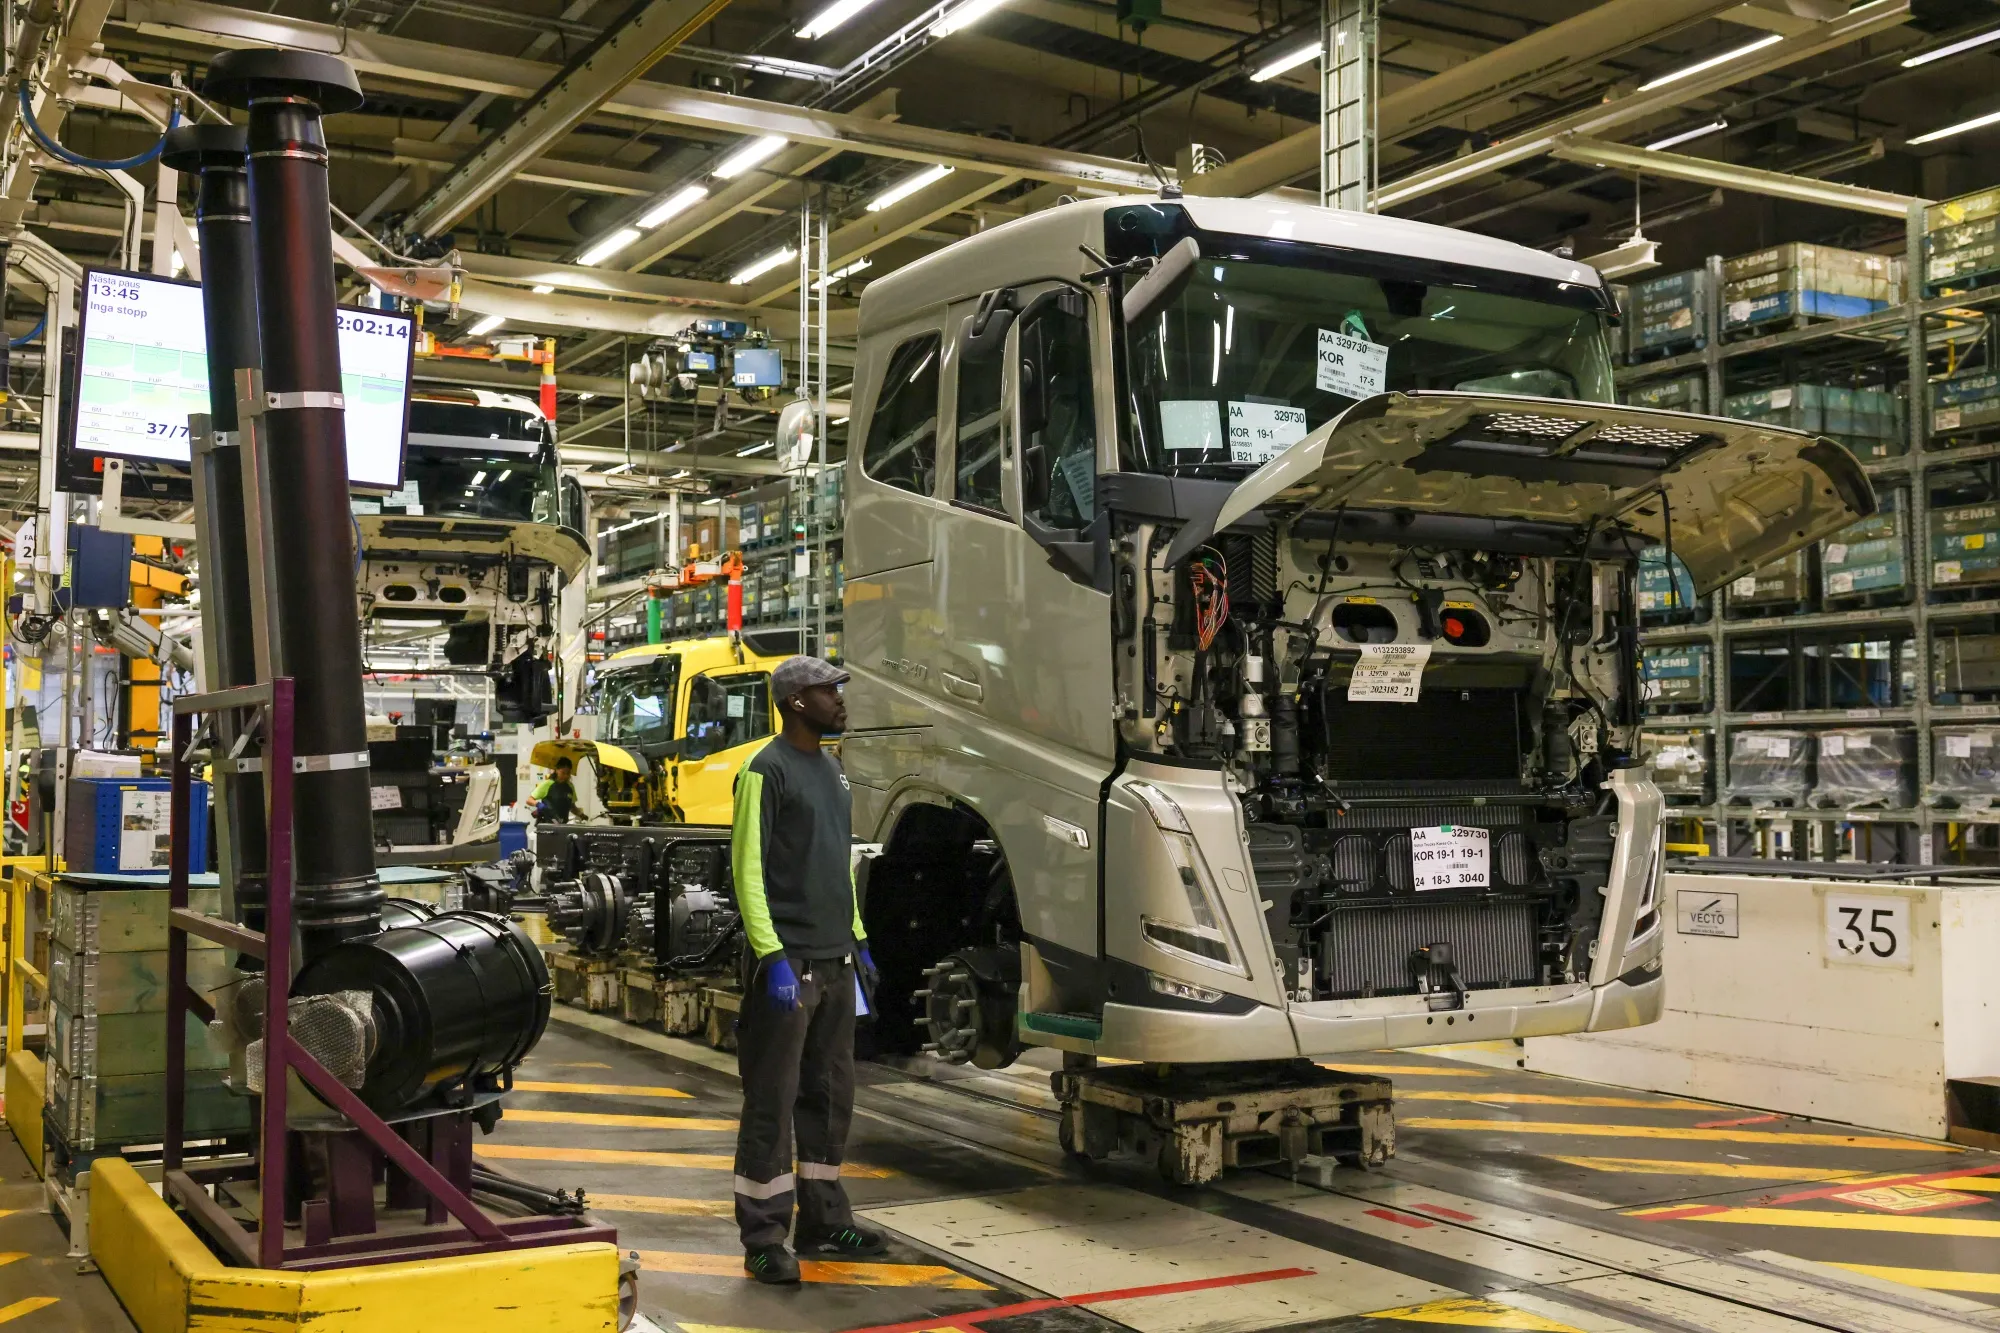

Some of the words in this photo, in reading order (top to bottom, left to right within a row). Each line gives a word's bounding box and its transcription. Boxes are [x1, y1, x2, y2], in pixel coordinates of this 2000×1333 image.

[1736, 251, 1778, 269] V-EMB
[90, 274, 116, 285] Nästa
[118, 280, 141, 288] paus
[1643, 276, 1682, 293] V-EMB
[1736, 273, 1778, 291] V-EMB
[91, 284, 139, 300] 13:45
[90, 301, 114, 313] Inga
[116, 308, 148, 318] stopp
[1319, 333, 1334, 344] AA
[1336, 337, 1368, 353] 329730
[1320, 350, 1344, 366] KOR
[1360, 375, 1375, 386] 17-5
[1230, 406, 1243, 418] AA
[1274, 410, 1305, 424] 329730
[1230, 427, 1249, 438] KOR
[1257, 428, 1273, 439] 19-1
[1943, 507, 1996, 522] V-EMB
[1650, 657, 1689, 669] V-EMB
[1370, 685, 1398, 694] 2023182
[1403, 686, 1414, 697] 21
[1662, 680, 1690, 690] EMB
[1413, 831, 1426, 840] AA
[1451, 829, 1487, 839] 329730
[1414, 851, 1434, 861] KOR
[1437, 849, 1454, 859] 19-1
[1461, 848, 1483, 858] 19-1
[1415, 877, 1425, 887] 24
[1432, 875, 1451, 885] 18-3
[1459, 873, 1484, 883] 3040
[1838, 907, 1896, 957] 35
